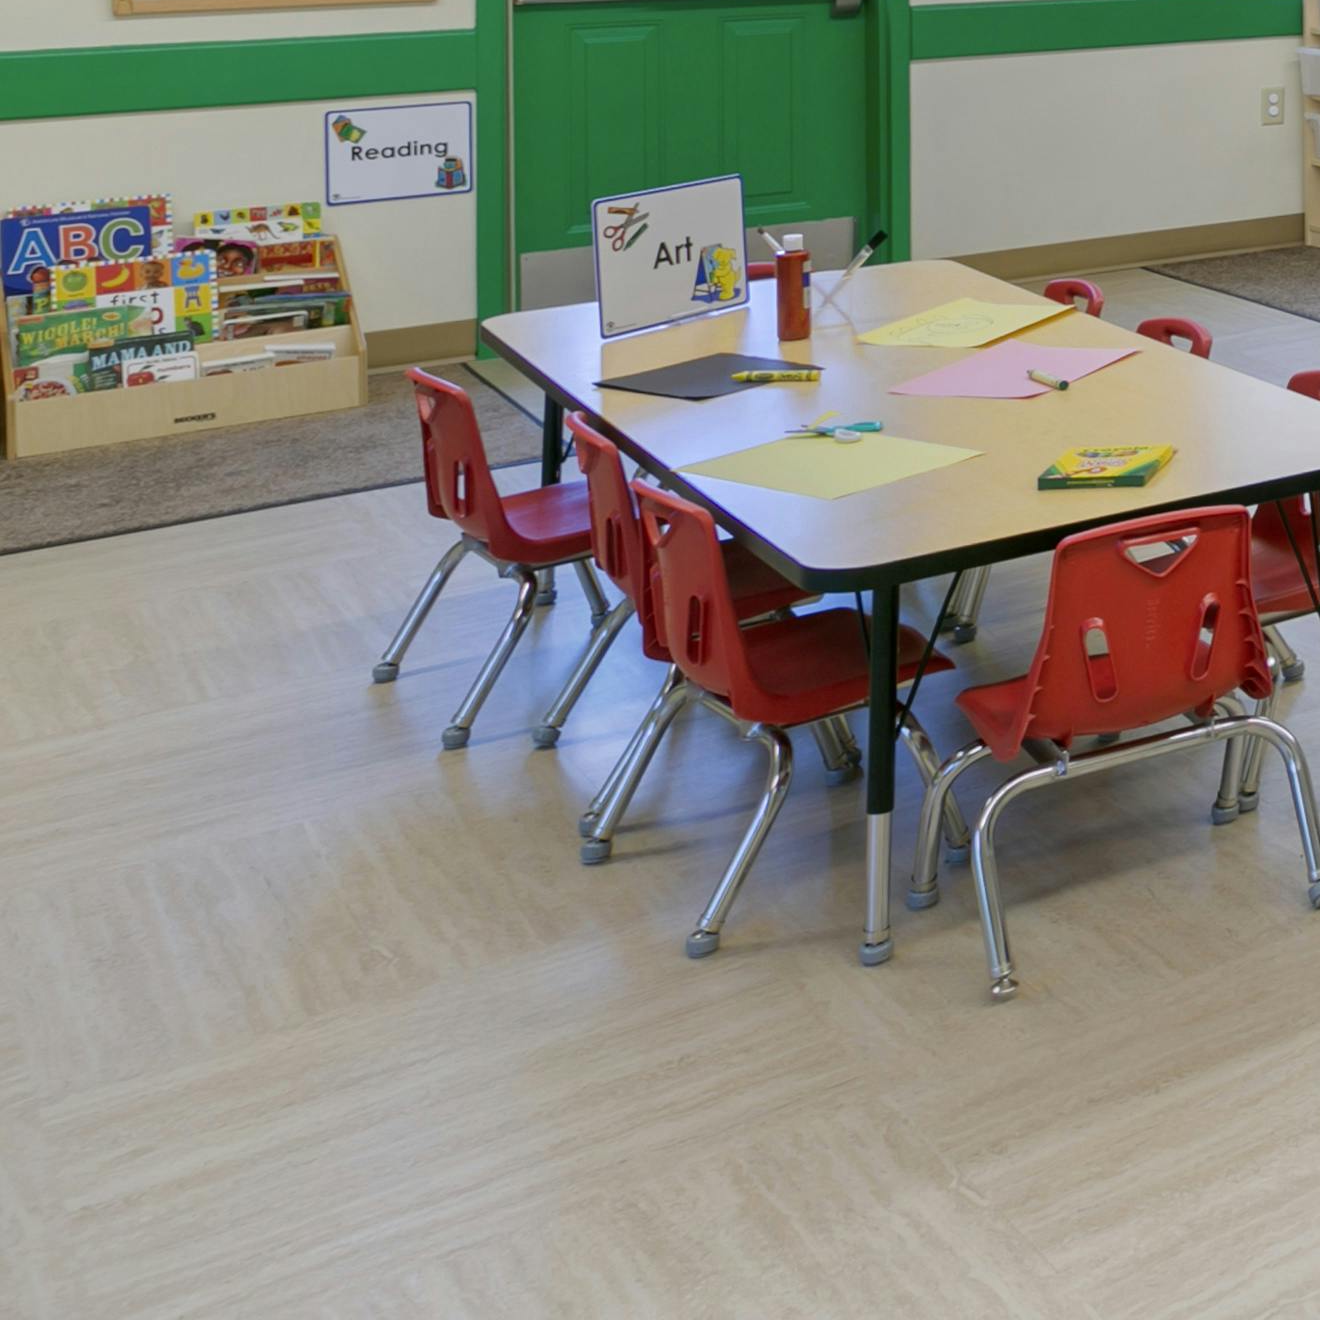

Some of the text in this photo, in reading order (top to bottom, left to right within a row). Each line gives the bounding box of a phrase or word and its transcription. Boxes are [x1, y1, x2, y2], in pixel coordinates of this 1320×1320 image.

[351, 140, 448, 162] Reading
[6, 217, 145, 276] ABC
[653, 235, 693, 270] Art
[20, 317, 97, 345] WIGGLE!
[91, 340, 192, 372] MAMA AND
